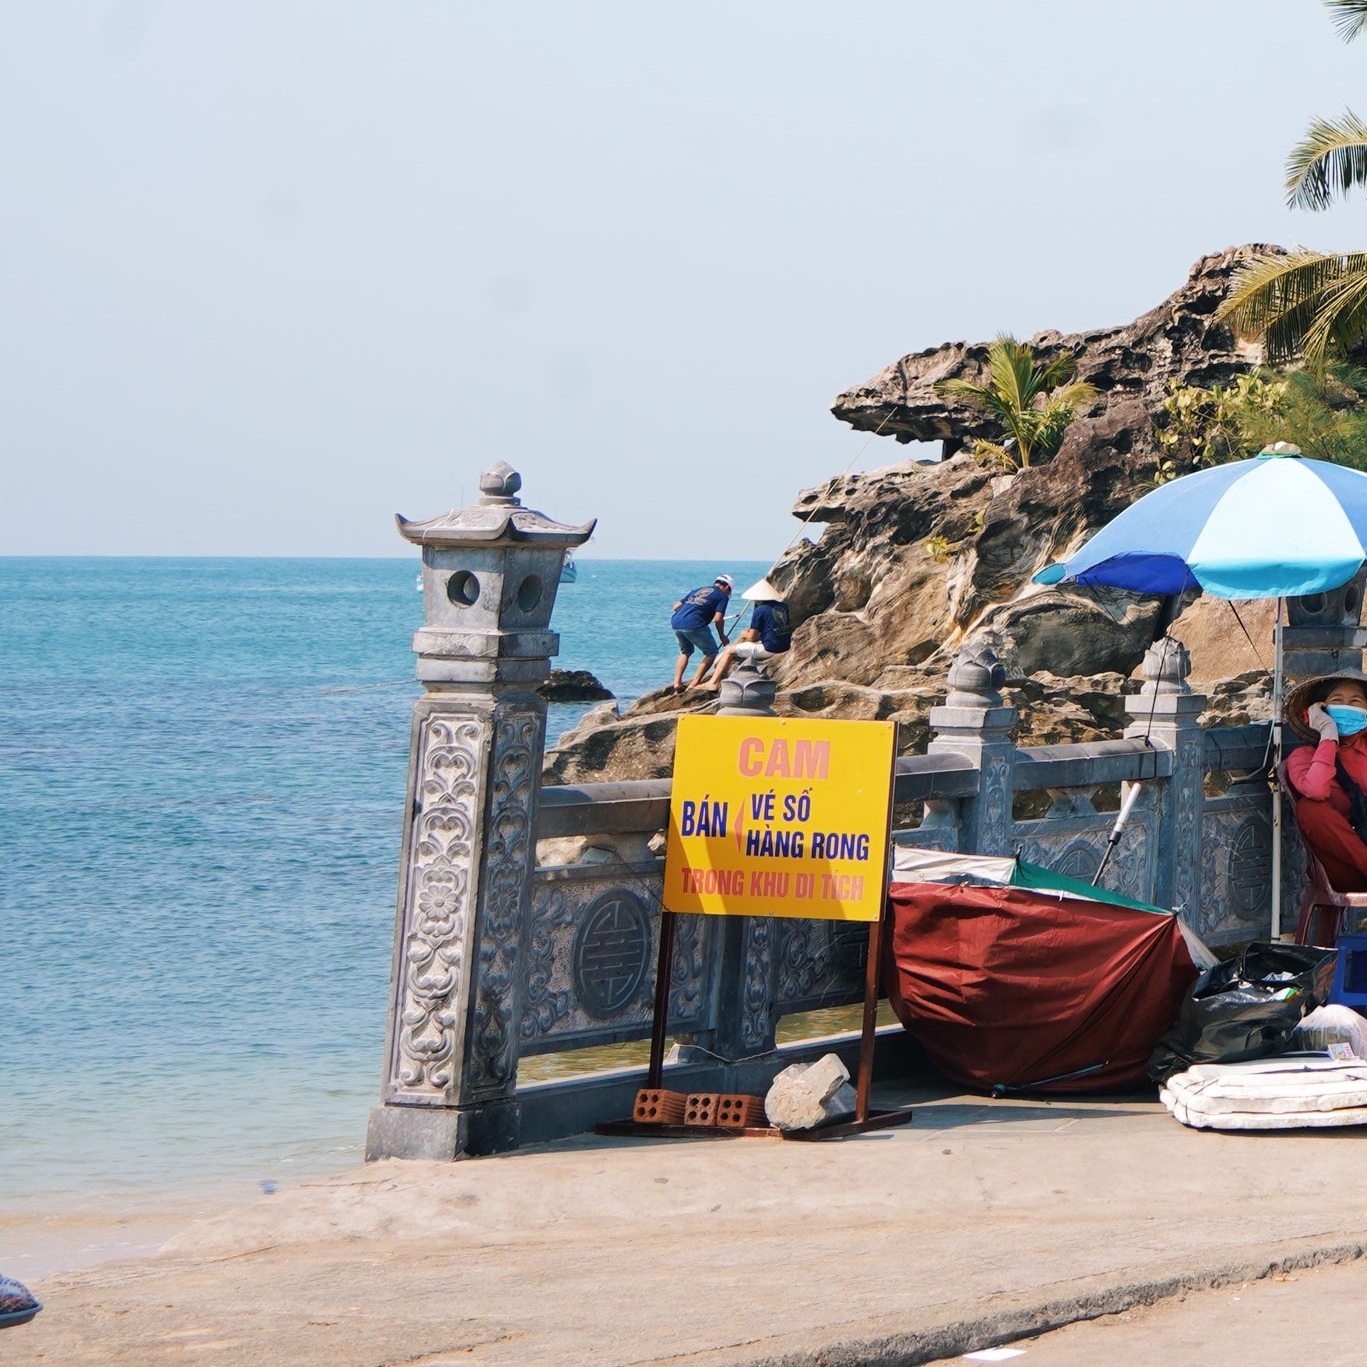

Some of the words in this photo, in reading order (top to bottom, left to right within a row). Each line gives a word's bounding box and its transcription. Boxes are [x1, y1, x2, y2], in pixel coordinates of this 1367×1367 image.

[681, 794, 729, 838] BÁN
[751, 789, 776, 821] VÉ
[782, 787, 813, 822] SỐ
[746, 824, 805, 859] HÀNG
[811, 832, 870, 861] RONG
[681, 867, 745, 896] TRONG
[750, 870, 790, 898] KHU
[795, 872, 815, 899] DI
[821, 869, 865, 901] TÍCH
